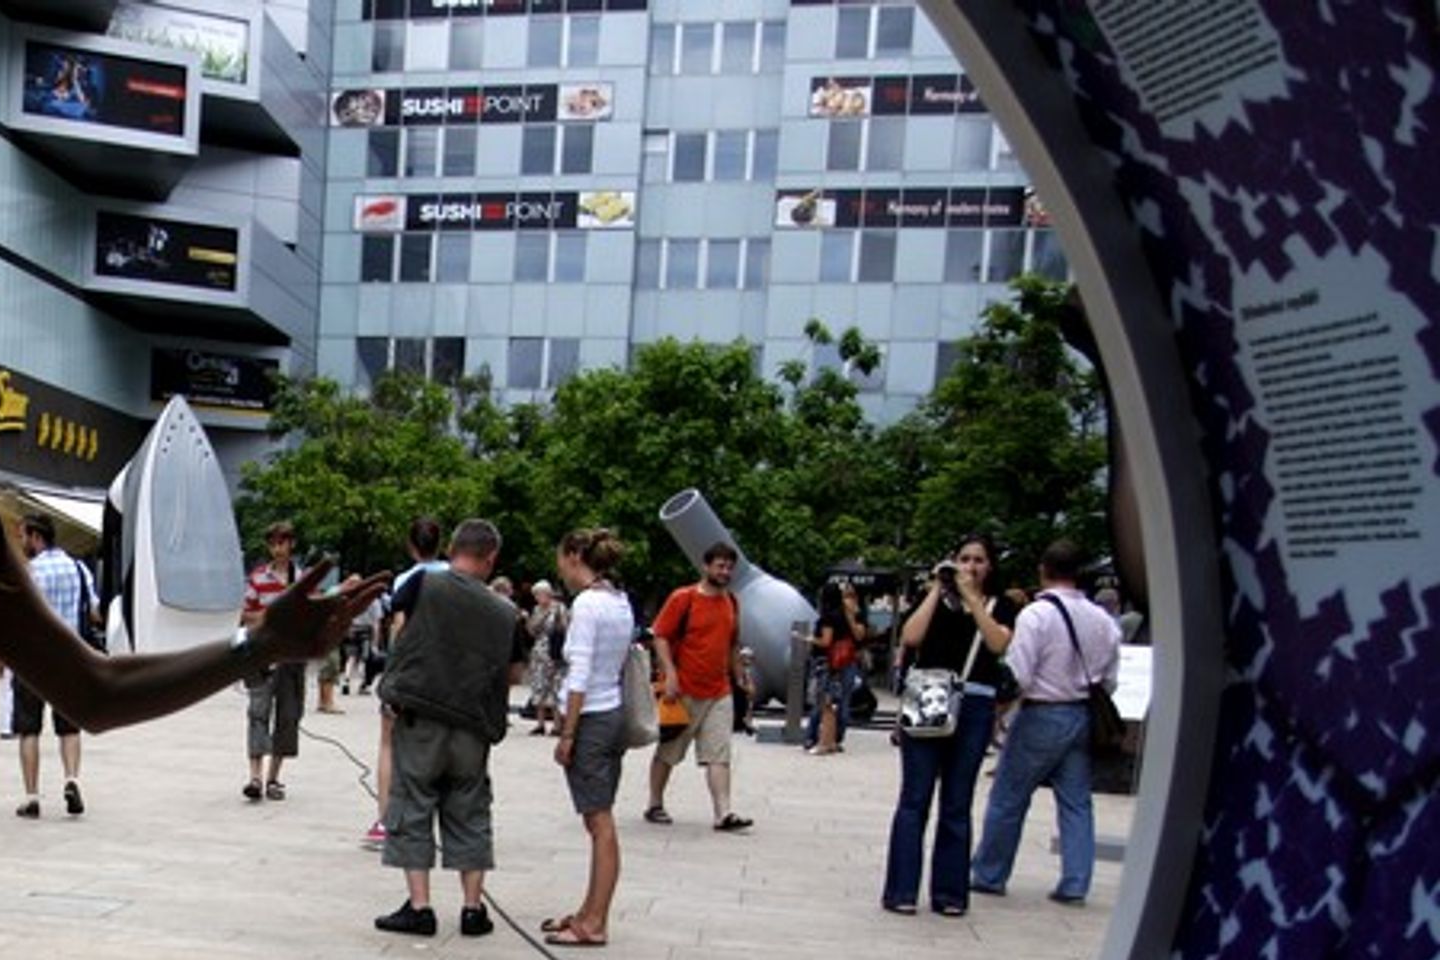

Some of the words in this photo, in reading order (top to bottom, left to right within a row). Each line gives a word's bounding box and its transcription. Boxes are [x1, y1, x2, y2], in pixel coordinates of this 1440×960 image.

[401, 97, 464, 117] SUSHI
[484, 94, 544, 114] POINT
[418, 202, 482, 222] SUSHI
[505, 201, 564, 220] POINT
